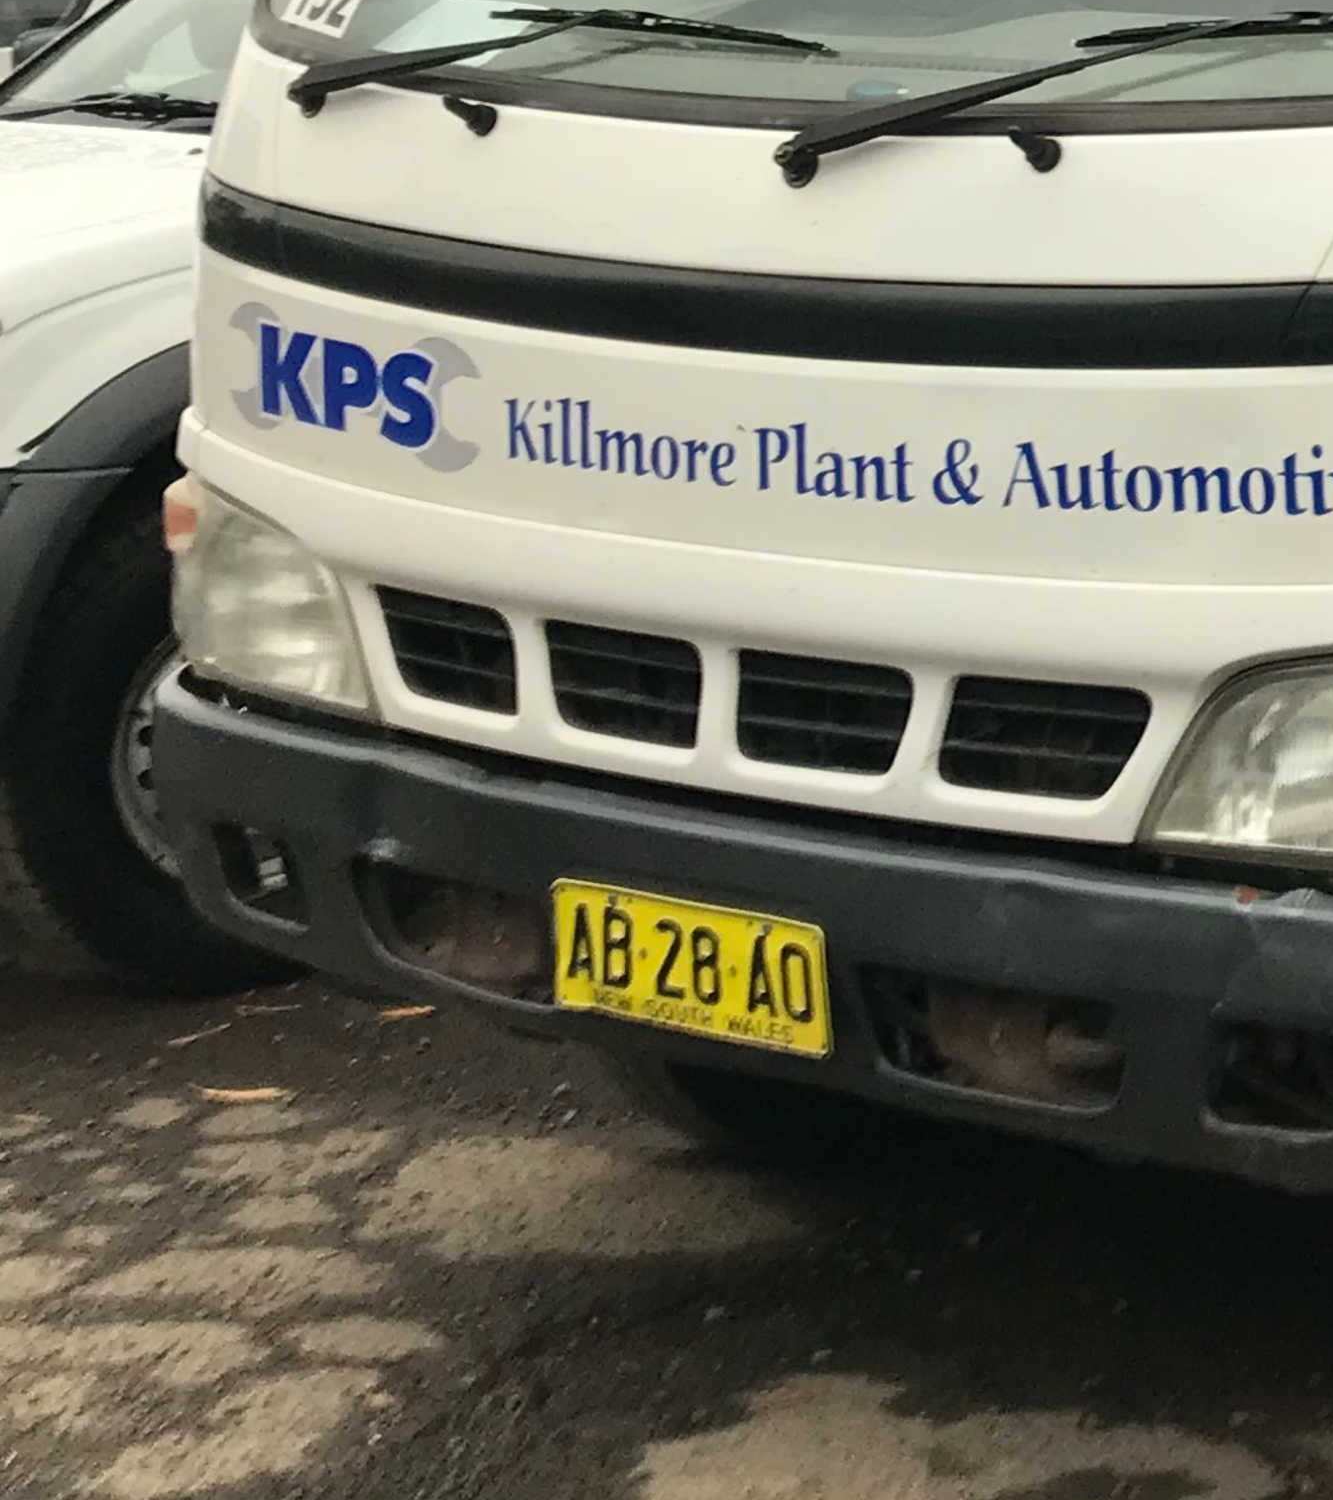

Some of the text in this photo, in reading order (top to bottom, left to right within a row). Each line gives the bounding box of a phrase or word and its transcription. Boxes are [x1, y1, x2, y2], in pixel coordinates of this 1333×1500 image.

[258, 323, 438, 449] KPS
[504, 398, 737, 487] Killmore
[755, 422, 916, 502] Plant
[931, 438, 984, 506] &
[726, 1014, 794, 1045] WALES
